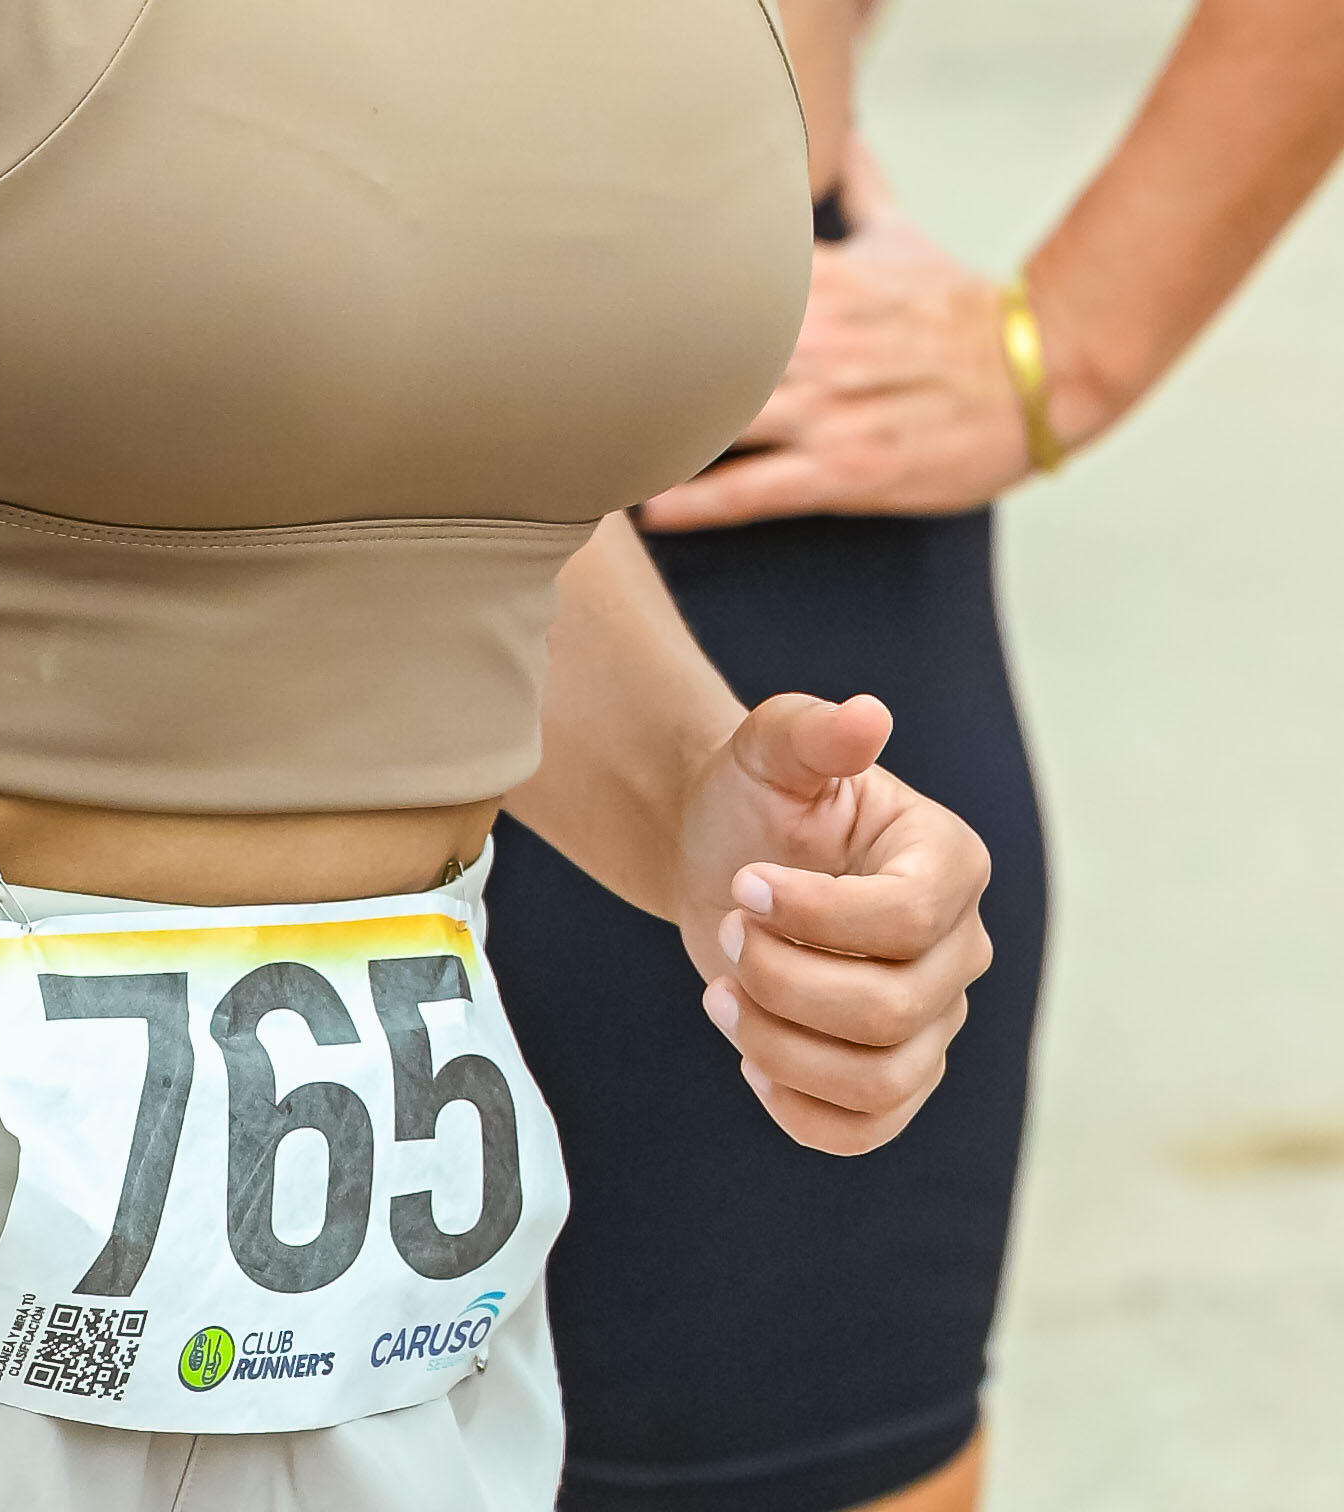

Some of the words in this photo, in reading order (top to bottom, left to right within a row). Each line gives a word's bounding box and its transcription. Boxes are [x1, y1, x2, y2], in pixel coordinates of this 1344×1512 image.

[38, 954, 523, 1297] 765
[9, 1306, 46, 1376] CLASIFICACIÓN
[233, 1351, 336, 1381] RUNNER'S
[242, 1330, 294, 1356] CLUB
[370, 1316, 492, 1368] CARUSO
